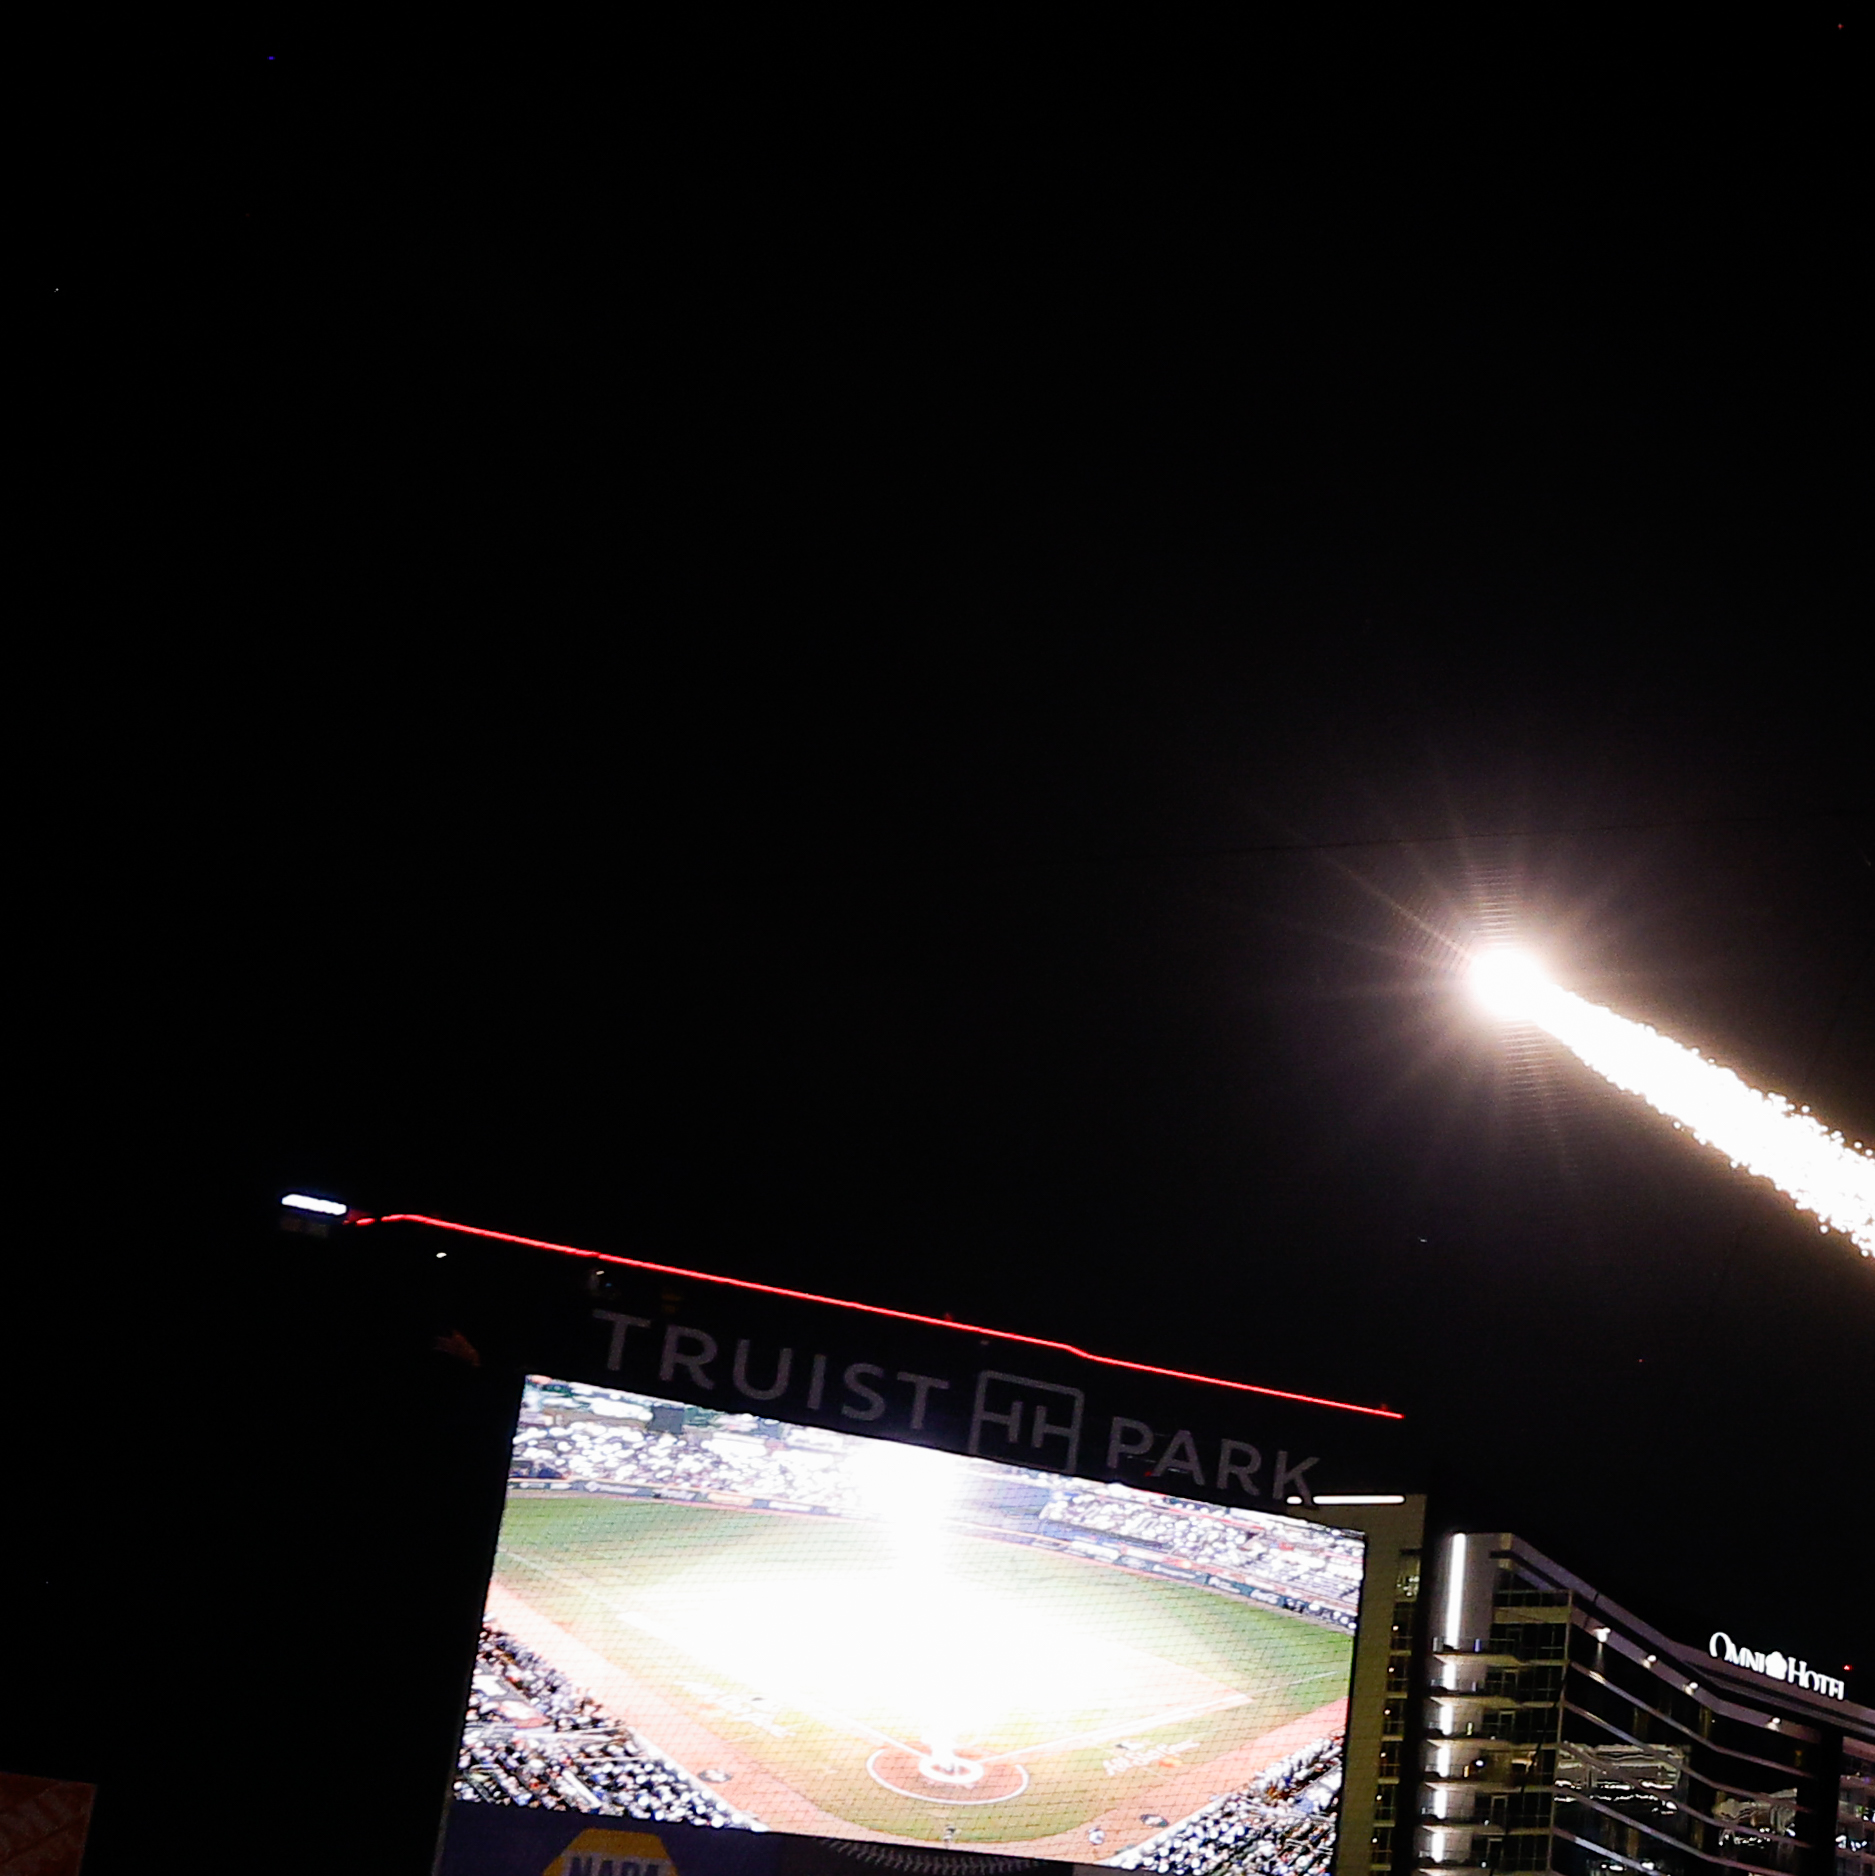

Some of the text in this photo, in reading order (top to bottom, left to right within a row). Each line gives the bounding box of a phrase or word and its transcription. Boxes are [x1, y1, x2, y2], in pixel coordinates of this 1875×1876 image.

[591, 1310, 1322, 1509] TRUIST PARK
[1709, 1631, 1766, 1674] OMNI
